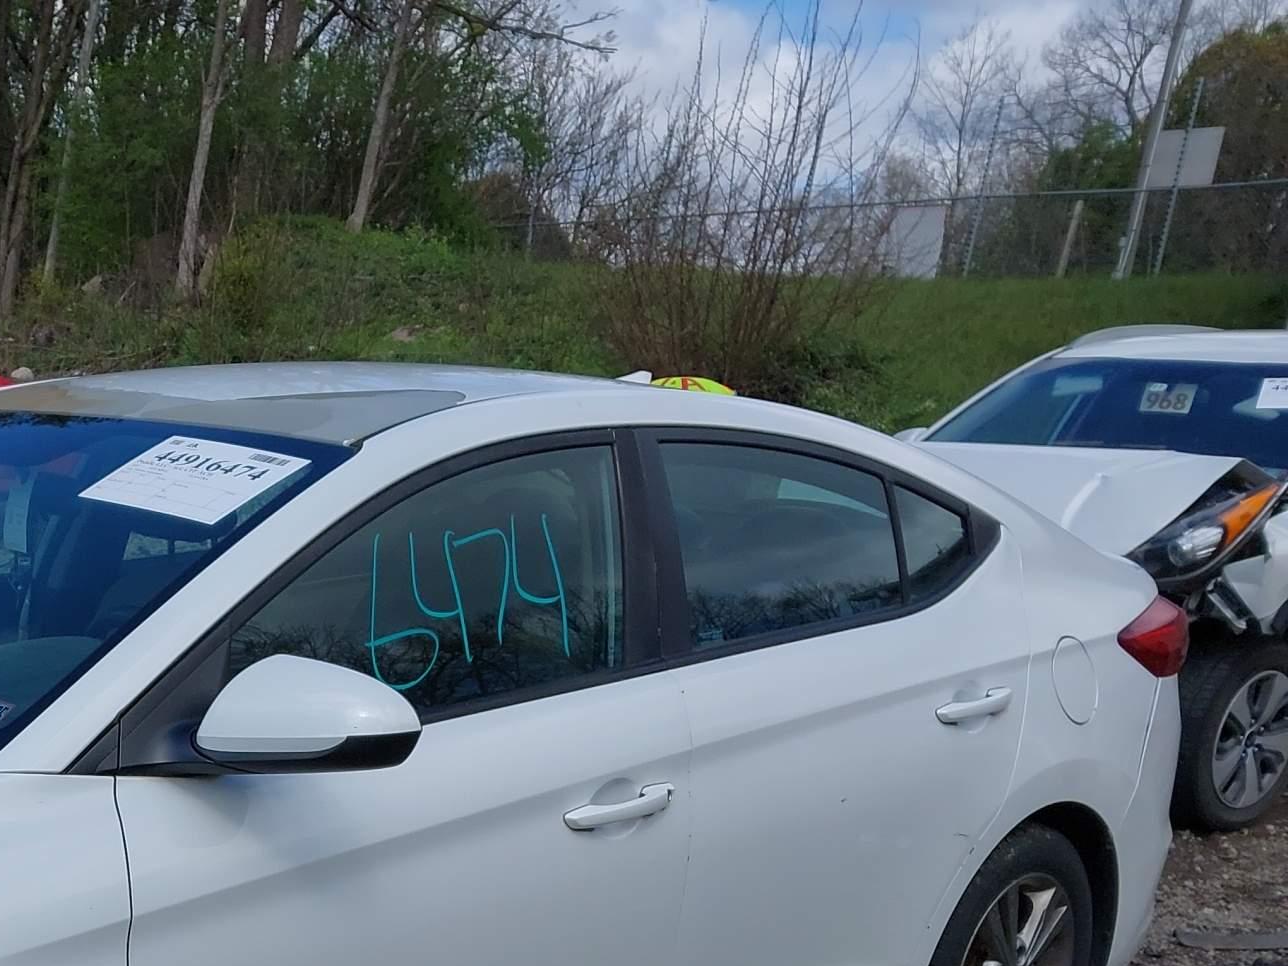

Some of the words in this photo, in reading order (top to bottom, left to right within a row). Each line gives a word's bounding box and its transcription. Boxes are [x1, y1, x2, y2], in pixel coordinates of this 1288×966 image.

[1147, 392, 1189, 410] 968
[154, 450, 270, 481] 44916474
[365, 513, 570, 690] 6474
